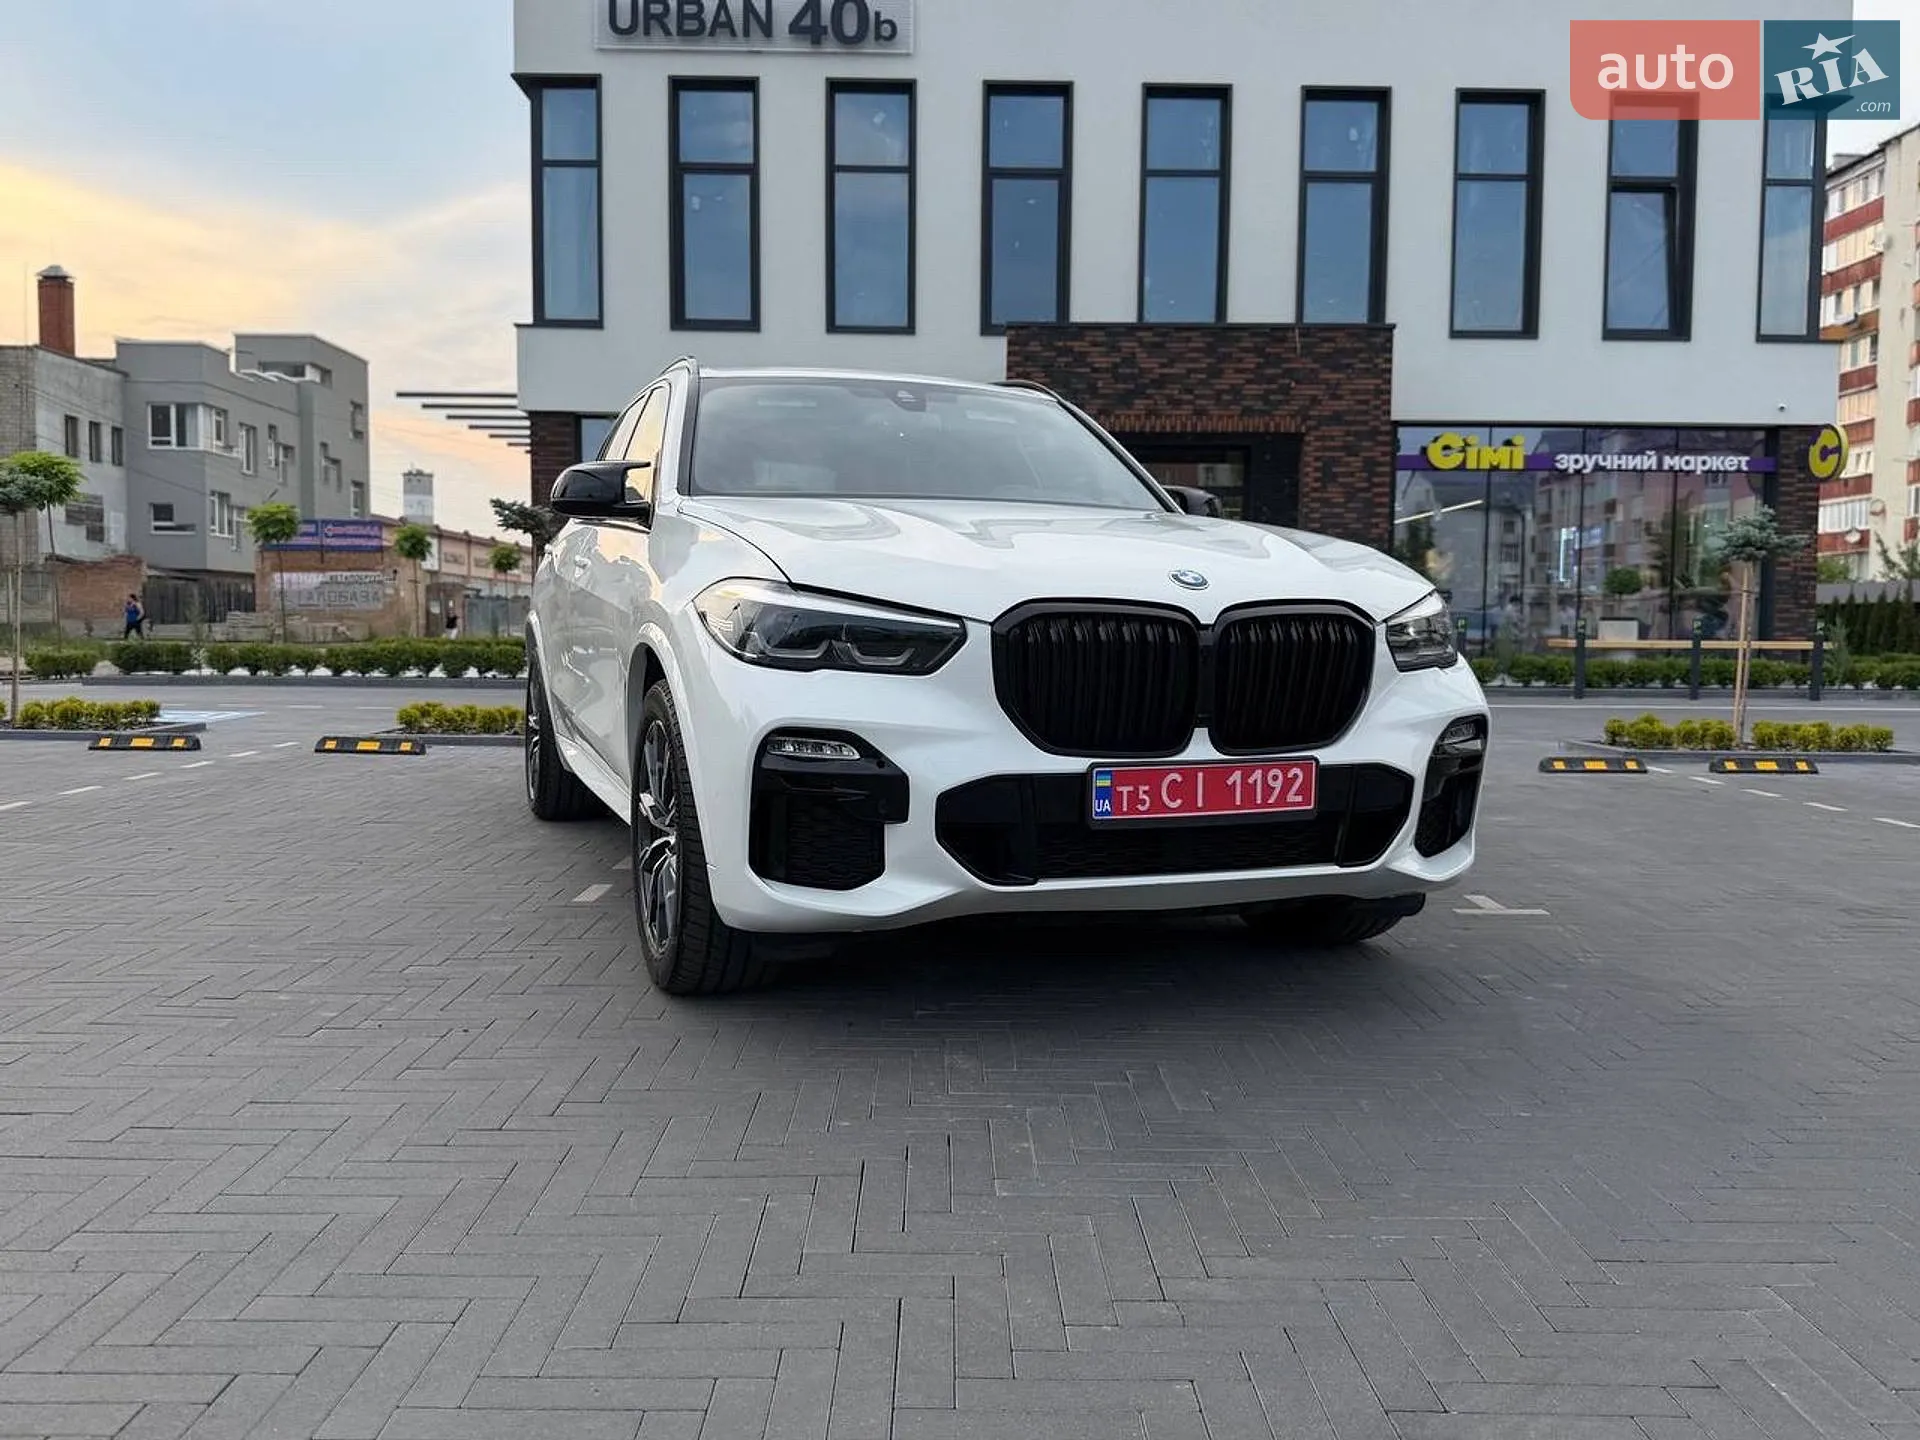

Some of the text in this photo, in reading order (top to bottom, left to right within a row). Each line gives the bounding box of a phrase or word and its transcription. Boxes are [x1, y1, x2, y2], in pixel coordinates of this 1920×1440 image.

[608, 0, 774, 38] URBAN
[1554, 450, 1752, 475] зручний маркет
[1226, 767, 1304, 806] 1192
[1094, 799, 1112, 813] UA
